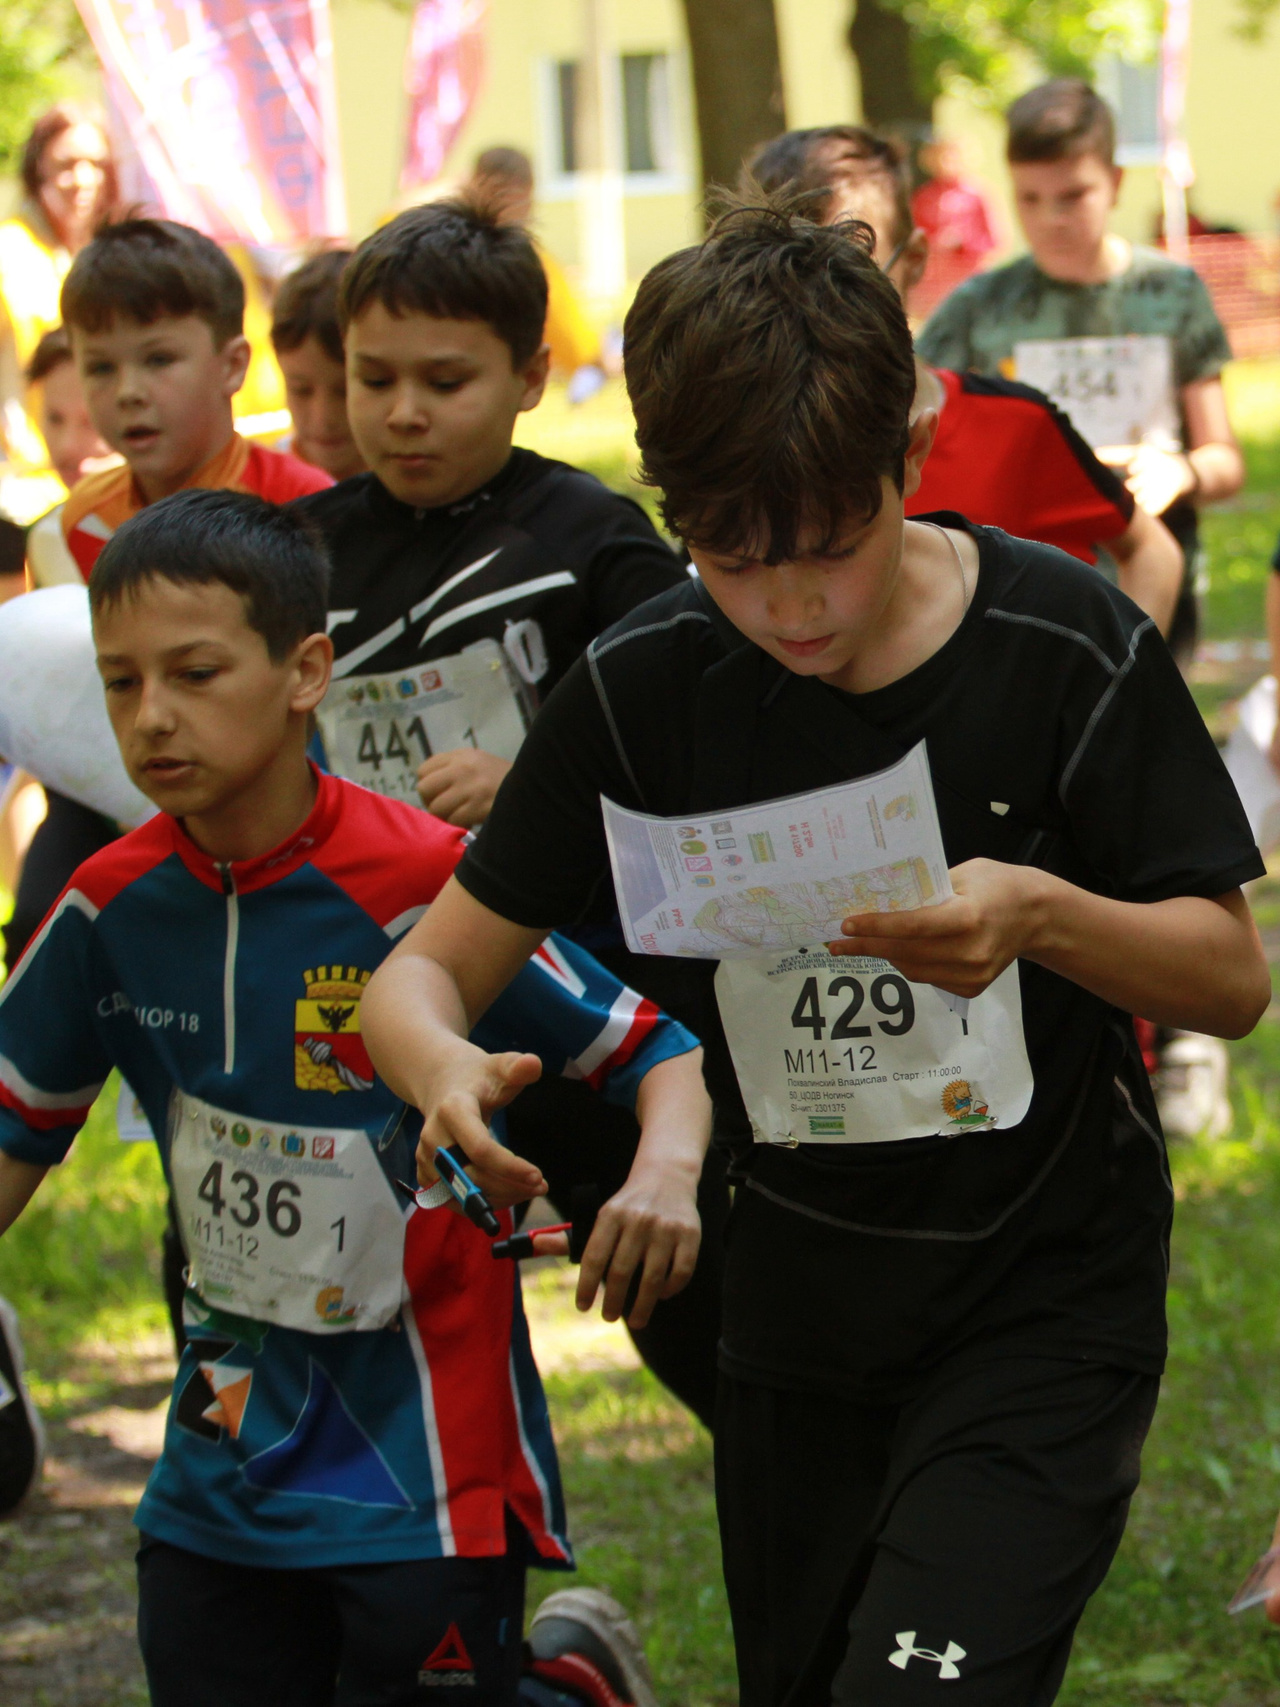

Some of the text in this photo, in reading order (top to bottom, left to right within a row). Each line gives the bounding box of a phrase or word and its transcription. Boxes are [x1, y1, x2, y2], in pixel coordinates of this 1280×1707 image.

[357, 716, 434, 771] 441
[790, 974, 916, 1041] 429
[179, 1012, 200, 1034] 18
[784, 1044, 878, 1074] М11-12
[837, 1074, 888, 1088] Владислав
[892, 1071, 920, 1083] Старт
[815, 1103, 847, 1113] 2301375
[823, 1091, 855, 1101] Ногинск
[197, 1160, 302, 1238] 436
[329, 1215, 346, 1254] 1
